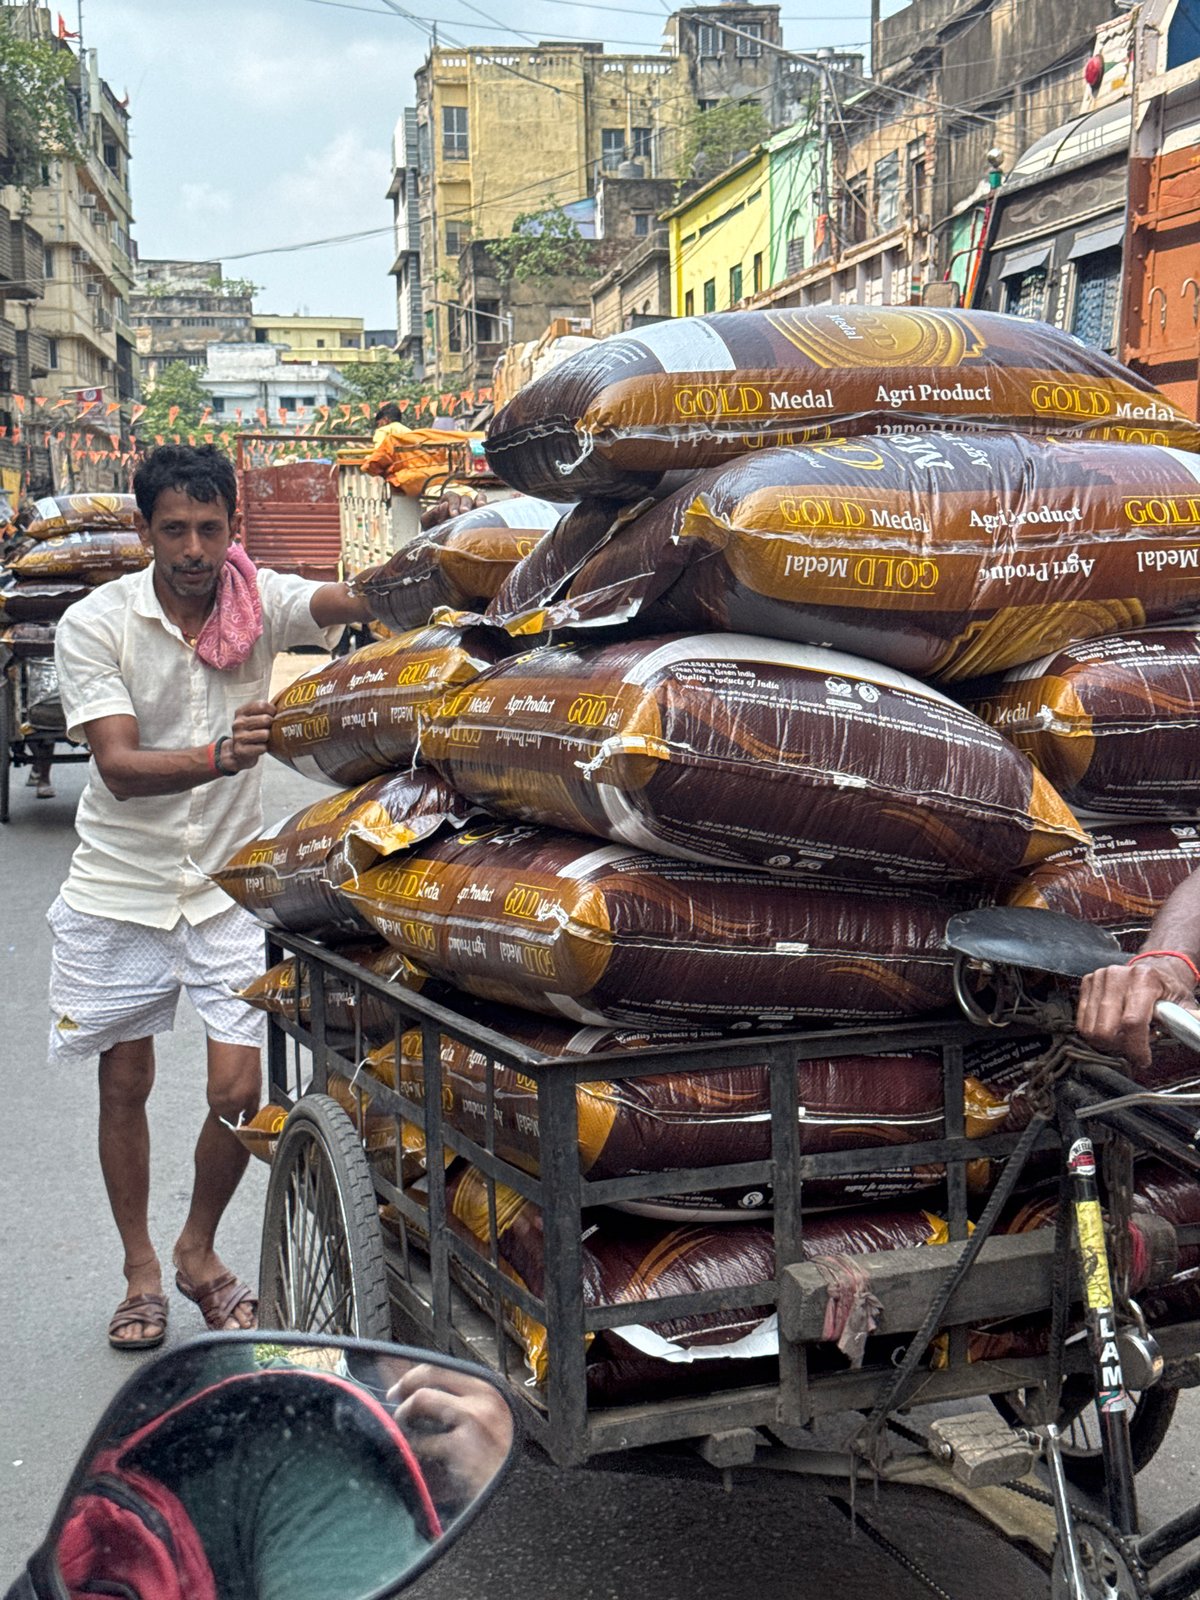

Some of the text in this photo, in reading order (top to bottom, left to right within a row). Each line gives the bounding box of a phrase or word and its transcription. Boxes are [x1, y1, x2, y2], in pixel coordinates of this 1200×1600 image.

[1054, 264, 1070, 330] WELCOM
[675, 386, 834, 416] GOLD Medal
[875, 383, 992, 410] Agri Product
[1031, 385, 1110, 415] GOLD
[780, 499, 931, 534] GOLD Medal
[969, 509, 1005, 533] Agri
[784, 554, 939, 589] GOLD Medal
[1054, 554, 1095, 579] Agri
[1136, 549, 1199, 573] Medal
[1076, 652, 1104, 663] Quality
[1104, 647, 1137, 658] Products
[1137, 645, 1145, 653] of
[1145, 644, 1166, 652] India
[398, 662, 430, 685] GOLD
[675, 672, 780, 690] Quality Products of India
[714, 669, 737, 677] Green
[737, 670, 756, 678] India
[390, 706, 413, 725] Medal
[468, 696, 495, 714] Medal
[504, 695, 556, 716] Agri Product
[568, 697, 607, 726] GOLD
[994, 701, 1031, 725] Medal
[1107, 840, 1115, 850] of
[1115, 838, 1137, 846] India
[377, 869, 418, 897] GOLD
[504, 887, 540, 916] GOLD
[404, 922, 436, 950] GOLD
[471, 935, 487, 959] Agri
[500, 941, 556, 977] GOLD Medal
[1096, 1308, 1122, 1387] LAM
